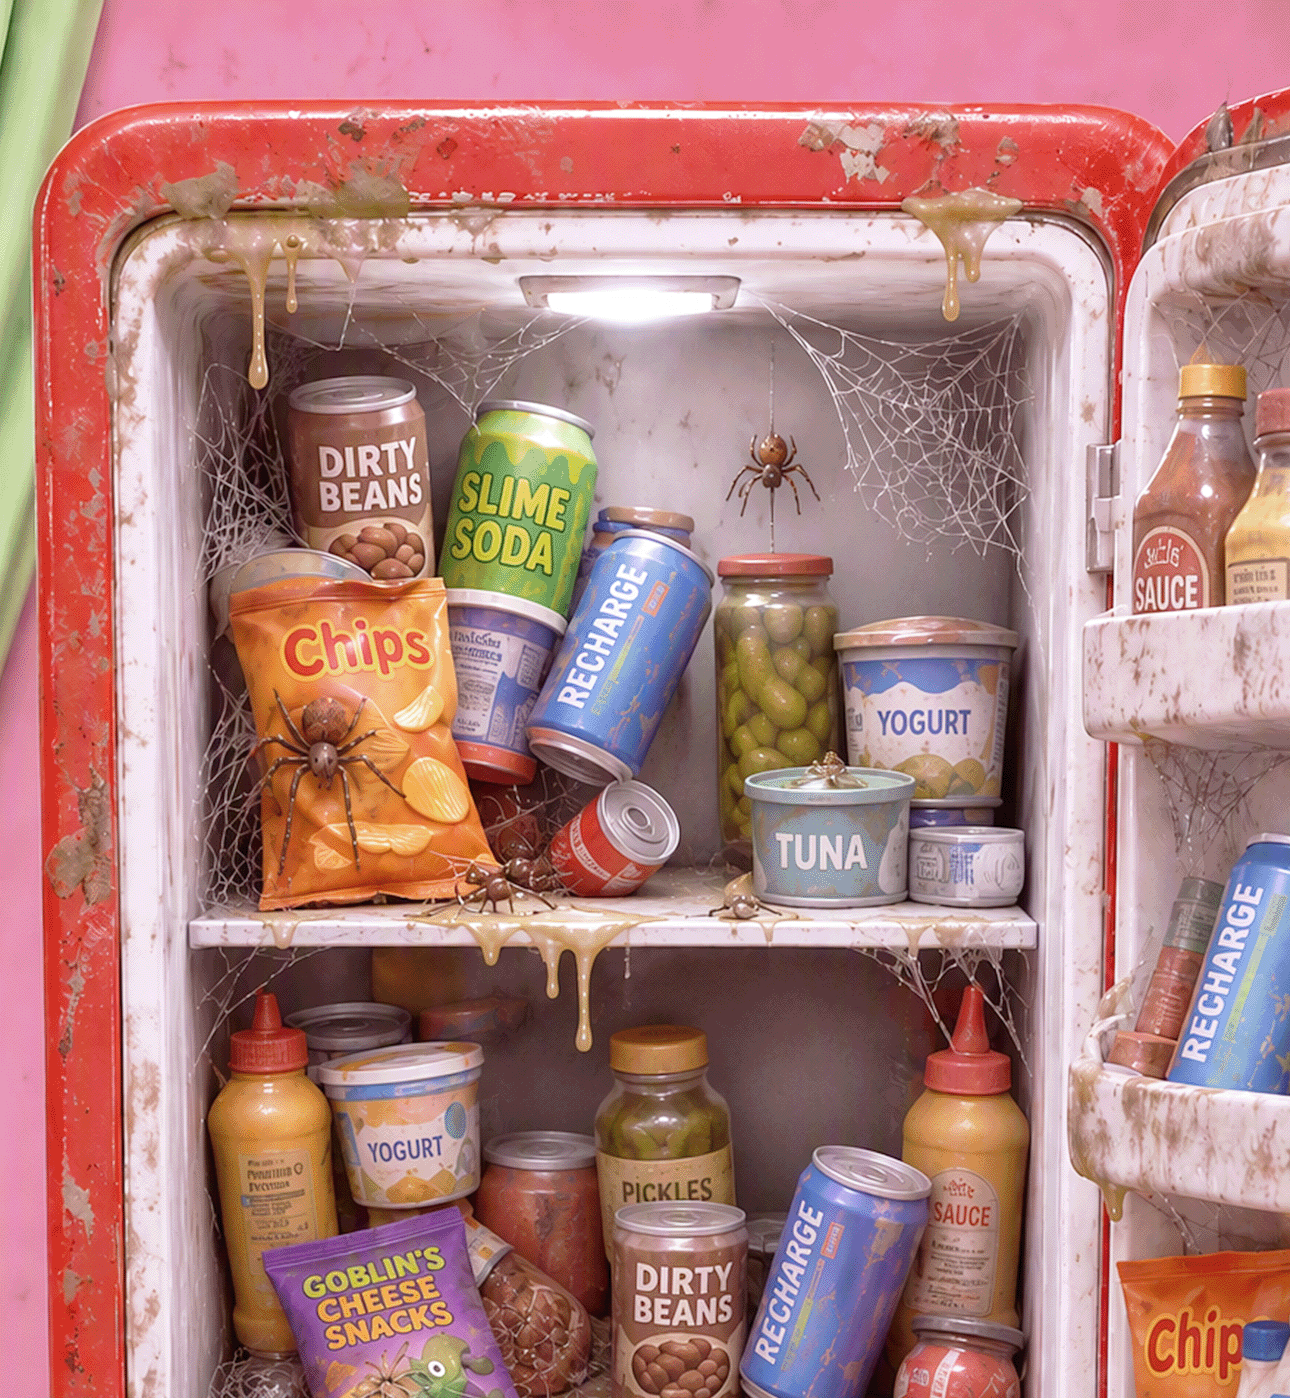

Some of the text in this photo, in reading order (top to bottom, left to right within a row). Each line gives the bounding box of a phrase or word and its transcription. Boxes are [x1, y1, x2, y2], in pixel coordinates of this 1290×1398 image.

[318, 436, 417, 478] DIRTY
[319, 470, 423, 513] BEANS
[457, 471, 571, 535] SLIME
[449, 517, 555, 577] SODA
[1135, 574, 1199, 612] SAUCE
[283, 617, 434, 680] Chips
[557, 563, 648, 711] RECHARGE
[877, 709, 971, 736] YOGURT
[775, 832, 868, 872] TUNA
[1181, 882, 1265, 1063] RECHARGE
[367, 1135, 444, 1163] YOGURT
[622, 1177, 713, 1204] PICKLES
[934, 1201, 991, 1227] SAUCE
[302, 1246, 447, 1300] GOBLIN'S
[636, 1262, 733, 1296] DIRTY
[754, 1200, 825, 1366] RECHARGE
[316, 1274, 441, 1324] CHEESE
[633, 1294, 733, 1327] BEANS
[325, 1301, 454, 1351] SNACKS
[1147, 1309, 1243, 1380] Chip
